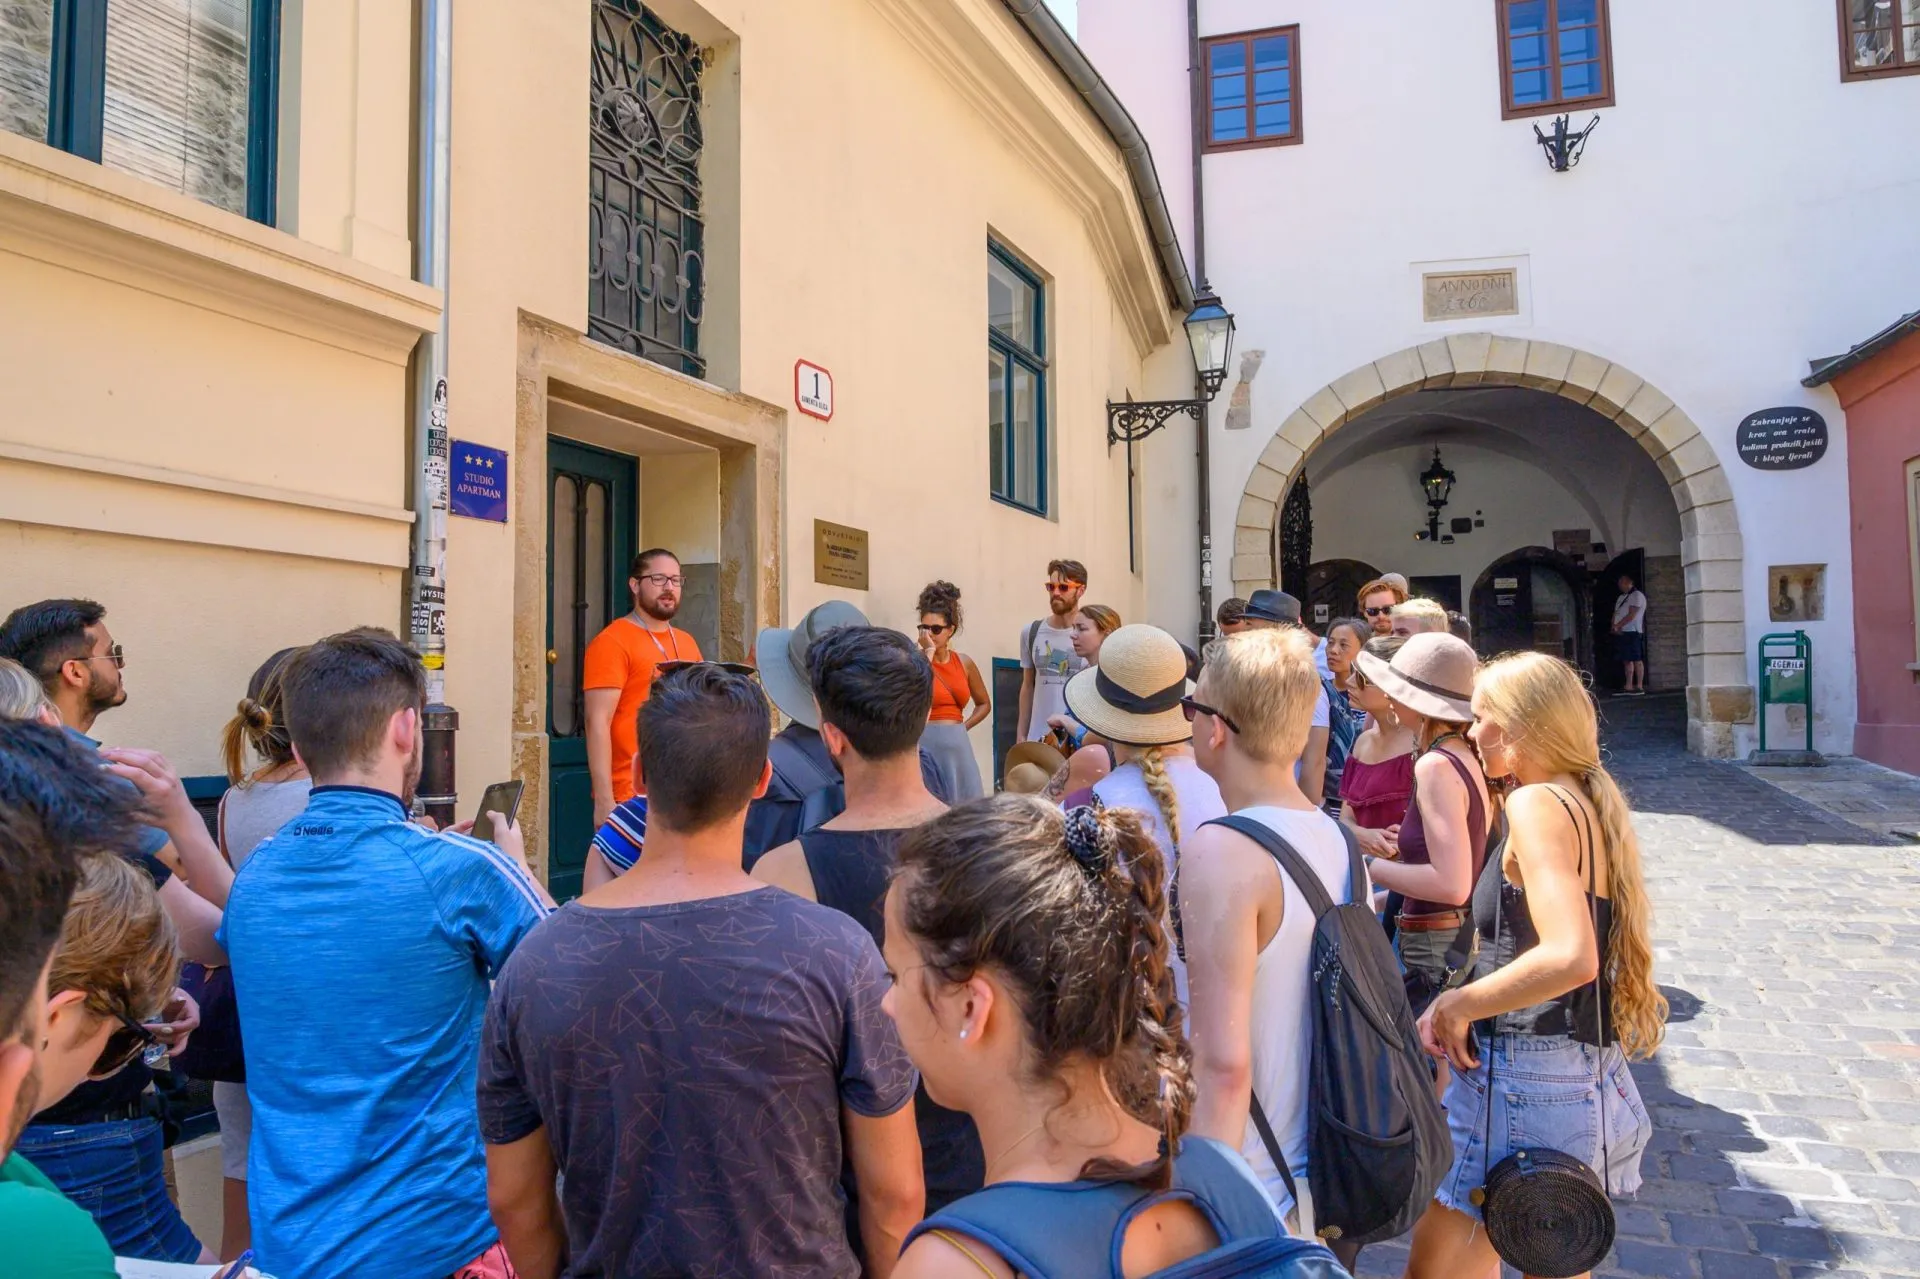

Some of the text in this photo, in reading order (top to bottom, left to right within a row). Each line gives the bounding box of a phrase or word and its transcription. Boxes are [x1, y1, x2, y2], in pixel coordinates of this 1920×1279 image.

[814, 372, 820, 400] 1
[1750, 416, 1798, 426] Zabranjuje
[1763, 454, 1784, 463] blago
[464, 472, 494, 486] STUDIO
[457, 484, 500, 499] APARTMAN
[419, 603, 430, 634] FUSE
